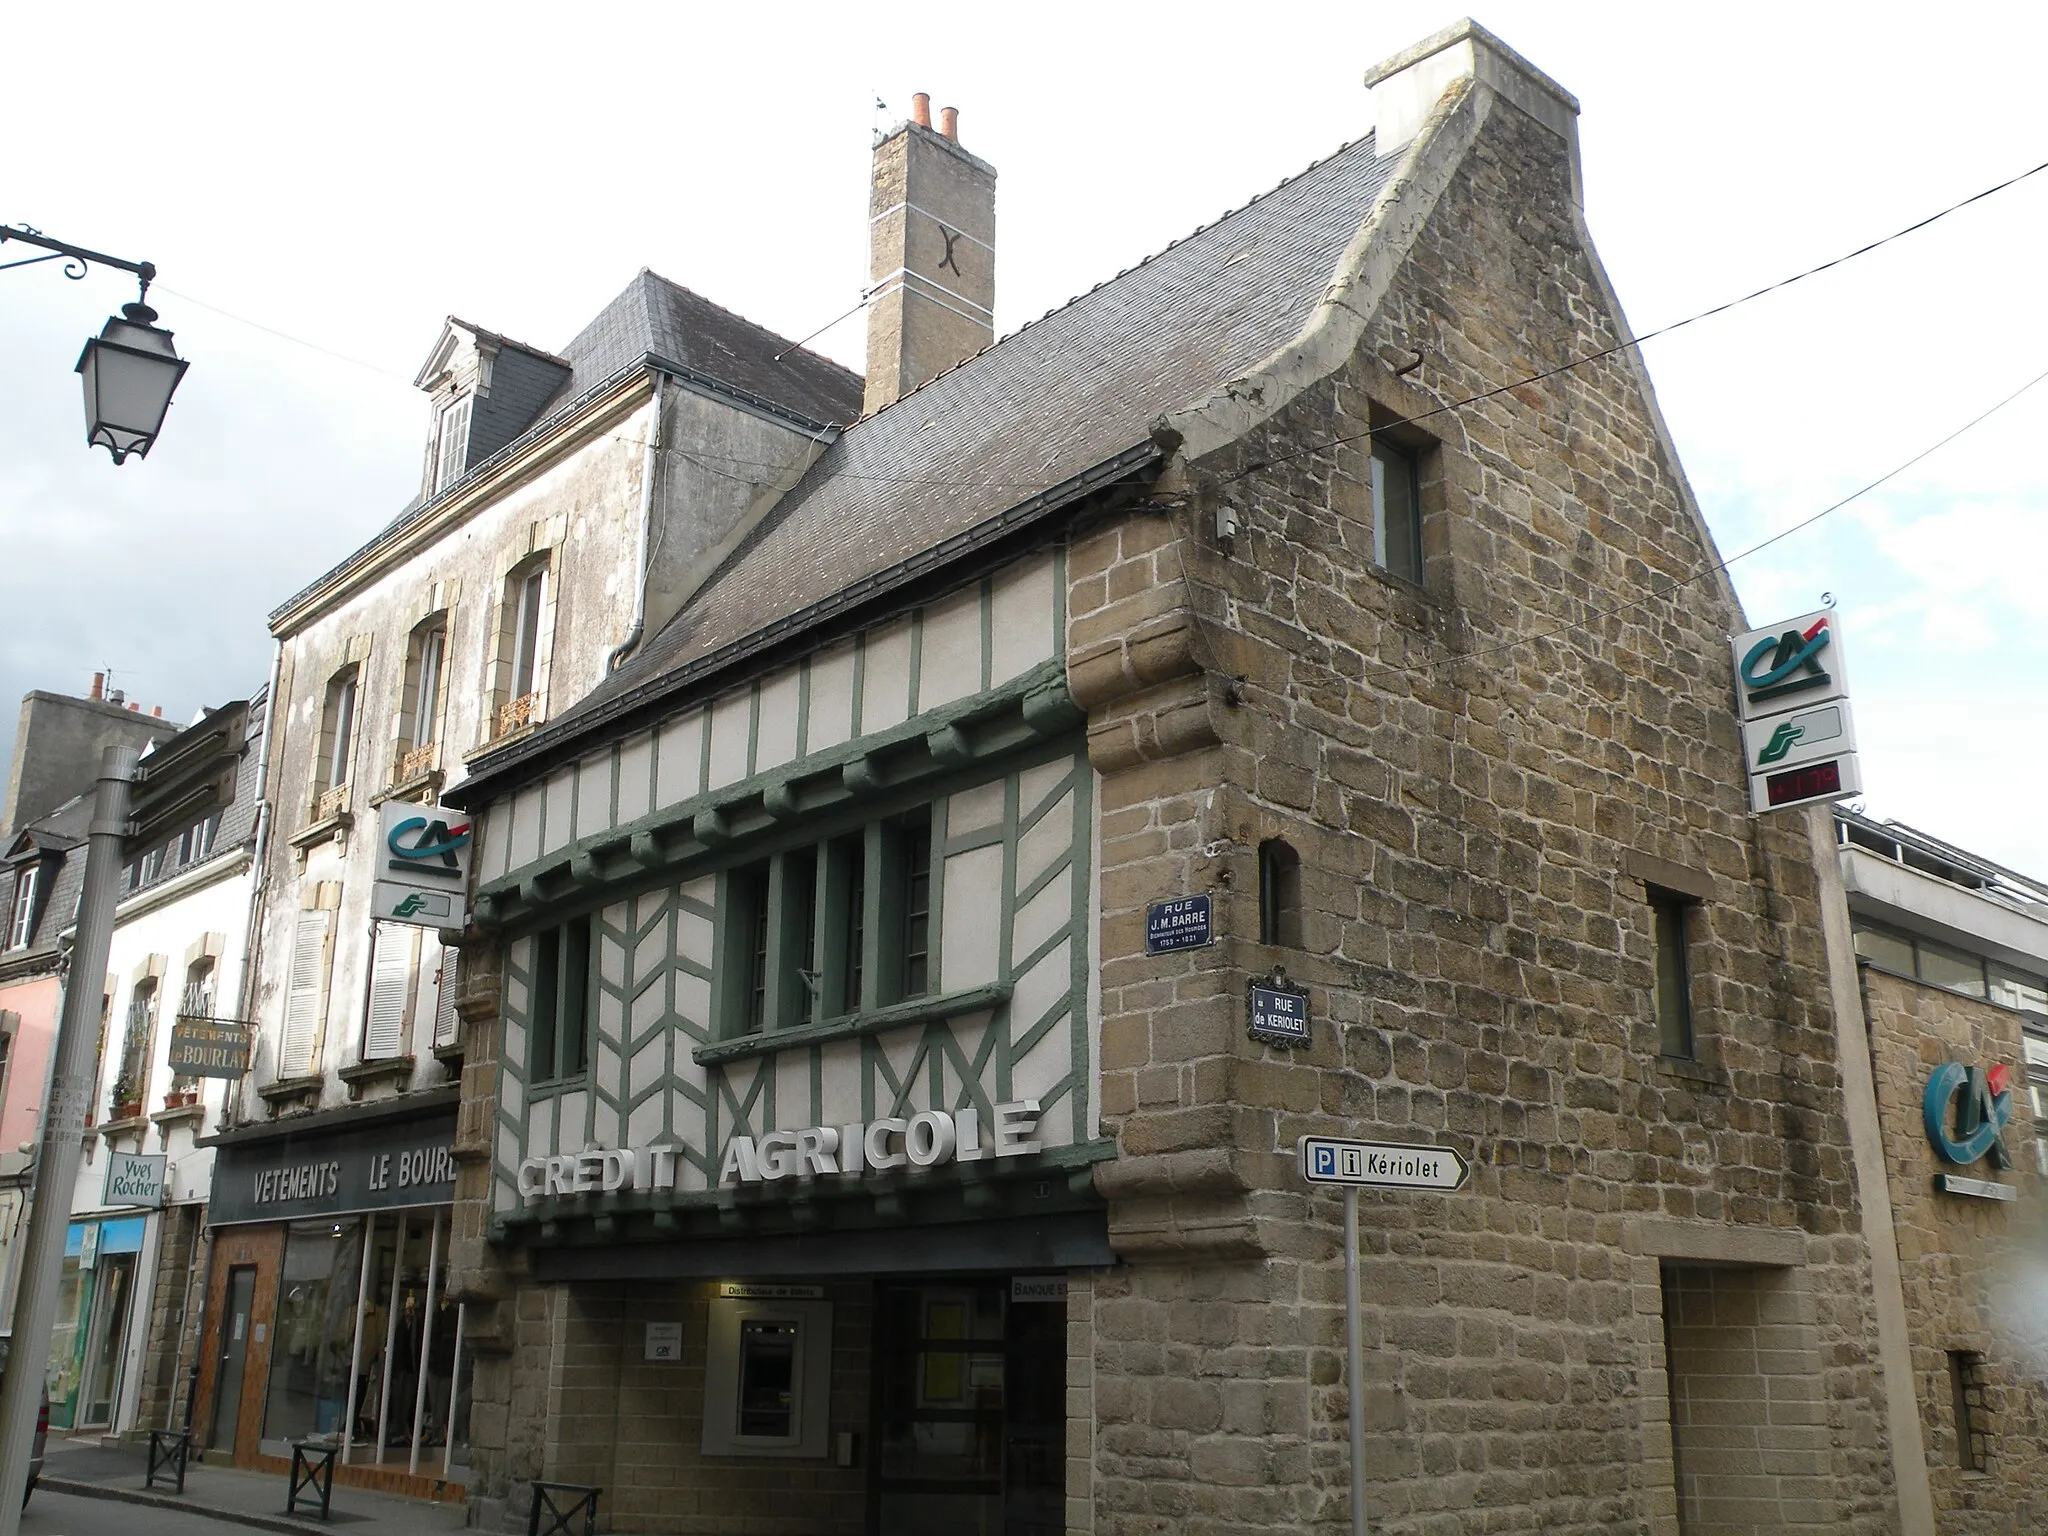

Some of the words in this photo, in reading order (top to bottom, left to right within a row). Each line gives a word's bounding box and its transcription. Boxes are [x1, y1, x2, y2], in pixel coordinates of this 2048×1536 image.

[1164, 900, 1193, 915] RUE
[1274, 997, 1293, 1013] RUE
[1255, 1012, 1265, 1025] de
[1267, 1013, 1304, 1032] KERIOLET
[182, 1044, 248, 1069] BOURLAY
[517, 1142, 685, 1198] CRÉDIT
[719, 1099, 1042, 1183] AGRICOLE
[125, 1160, 152, 1181] Yves
[1318, 1149, 1332, 1173] P
[1367, 1153, 1439, 1178] Kériolet
[113, 1175, 160, 1196] Rocher
[254, 1160, 340, 1204] VETEMENTS
[369, 1154, 390, 1191] LE
[1014, 1282, 1055, 1297] BANQUE
